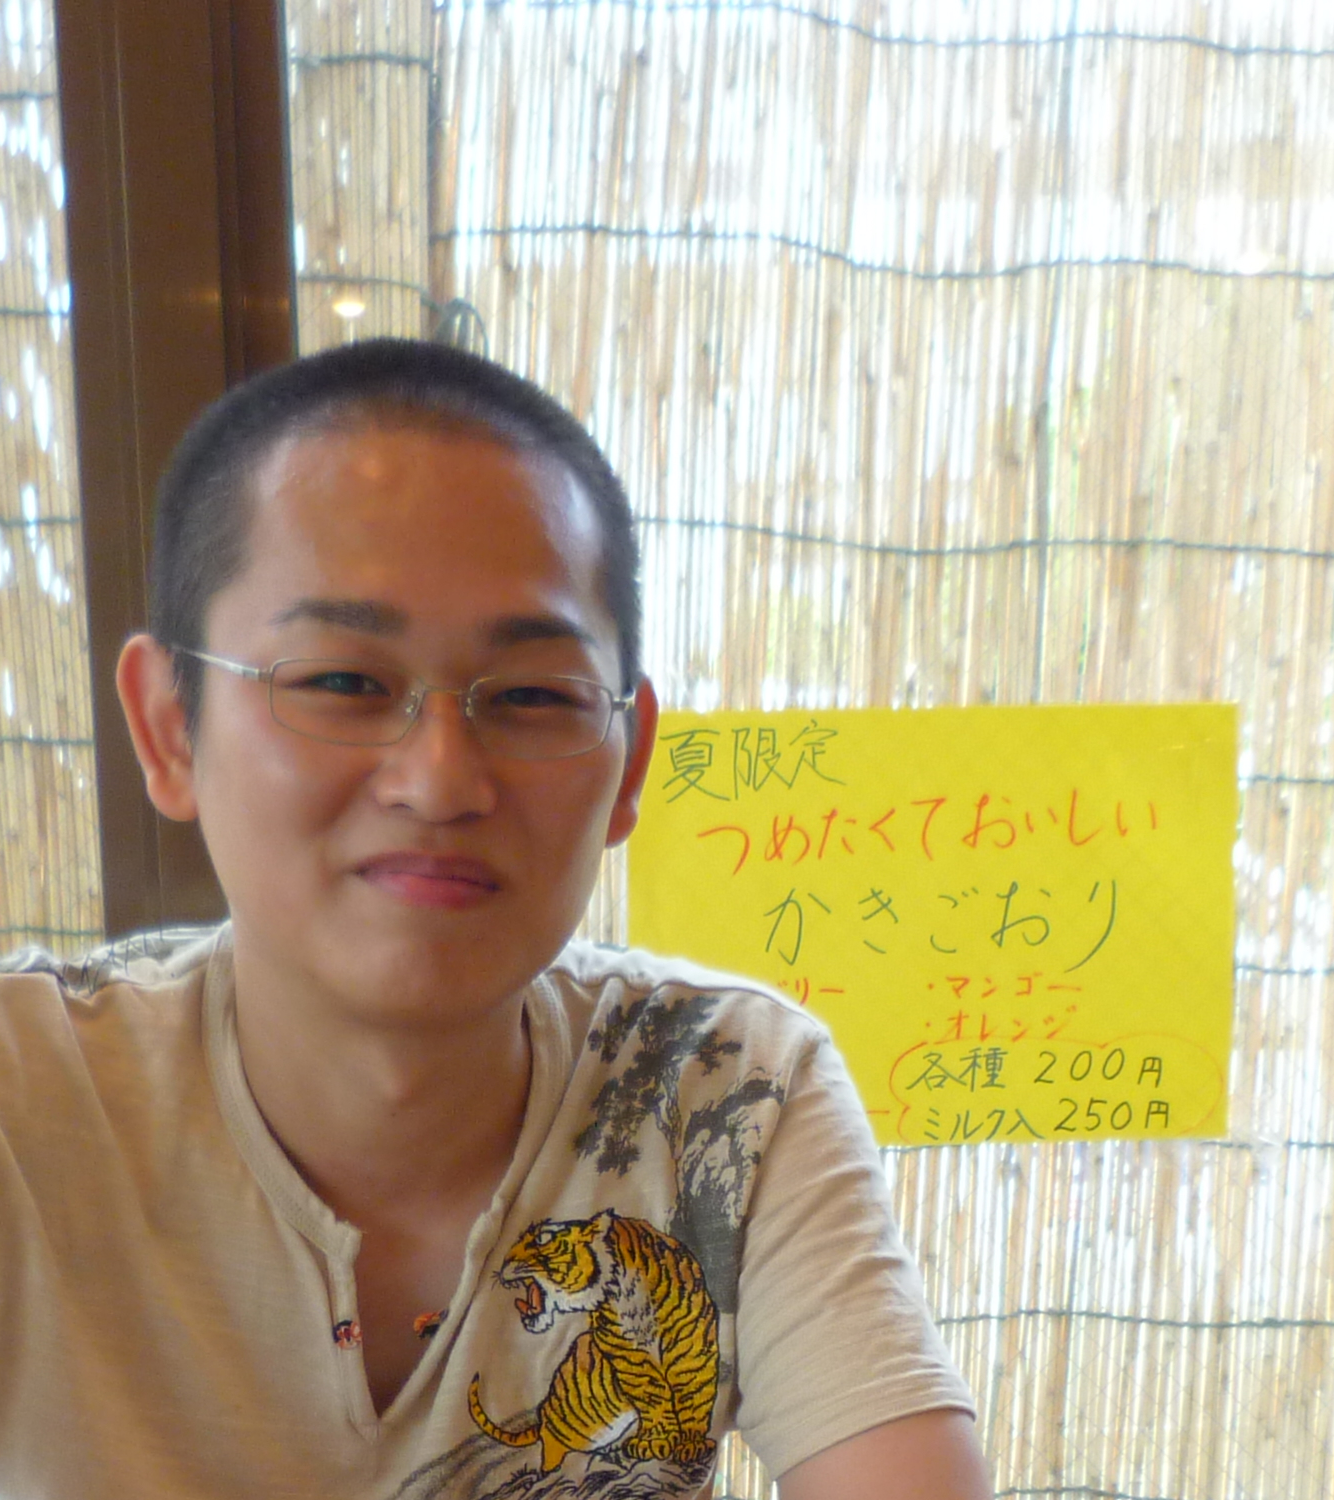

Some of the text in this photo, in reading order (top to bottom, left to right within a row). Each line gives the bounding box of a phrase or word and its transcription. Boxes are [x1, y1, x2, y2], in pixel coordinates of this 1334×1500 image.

[658, 718, 848, 804] 夏限定
[696, 788, 1159, 877] つめたくておいしい
[763, 879, 1118, 974] かきごおり
[777, 977, 845, 1007] リー
[905, 1046, 1163, 1093] 各種 200円
[922, 1097, 1170, 1142] ミルク入 250円
